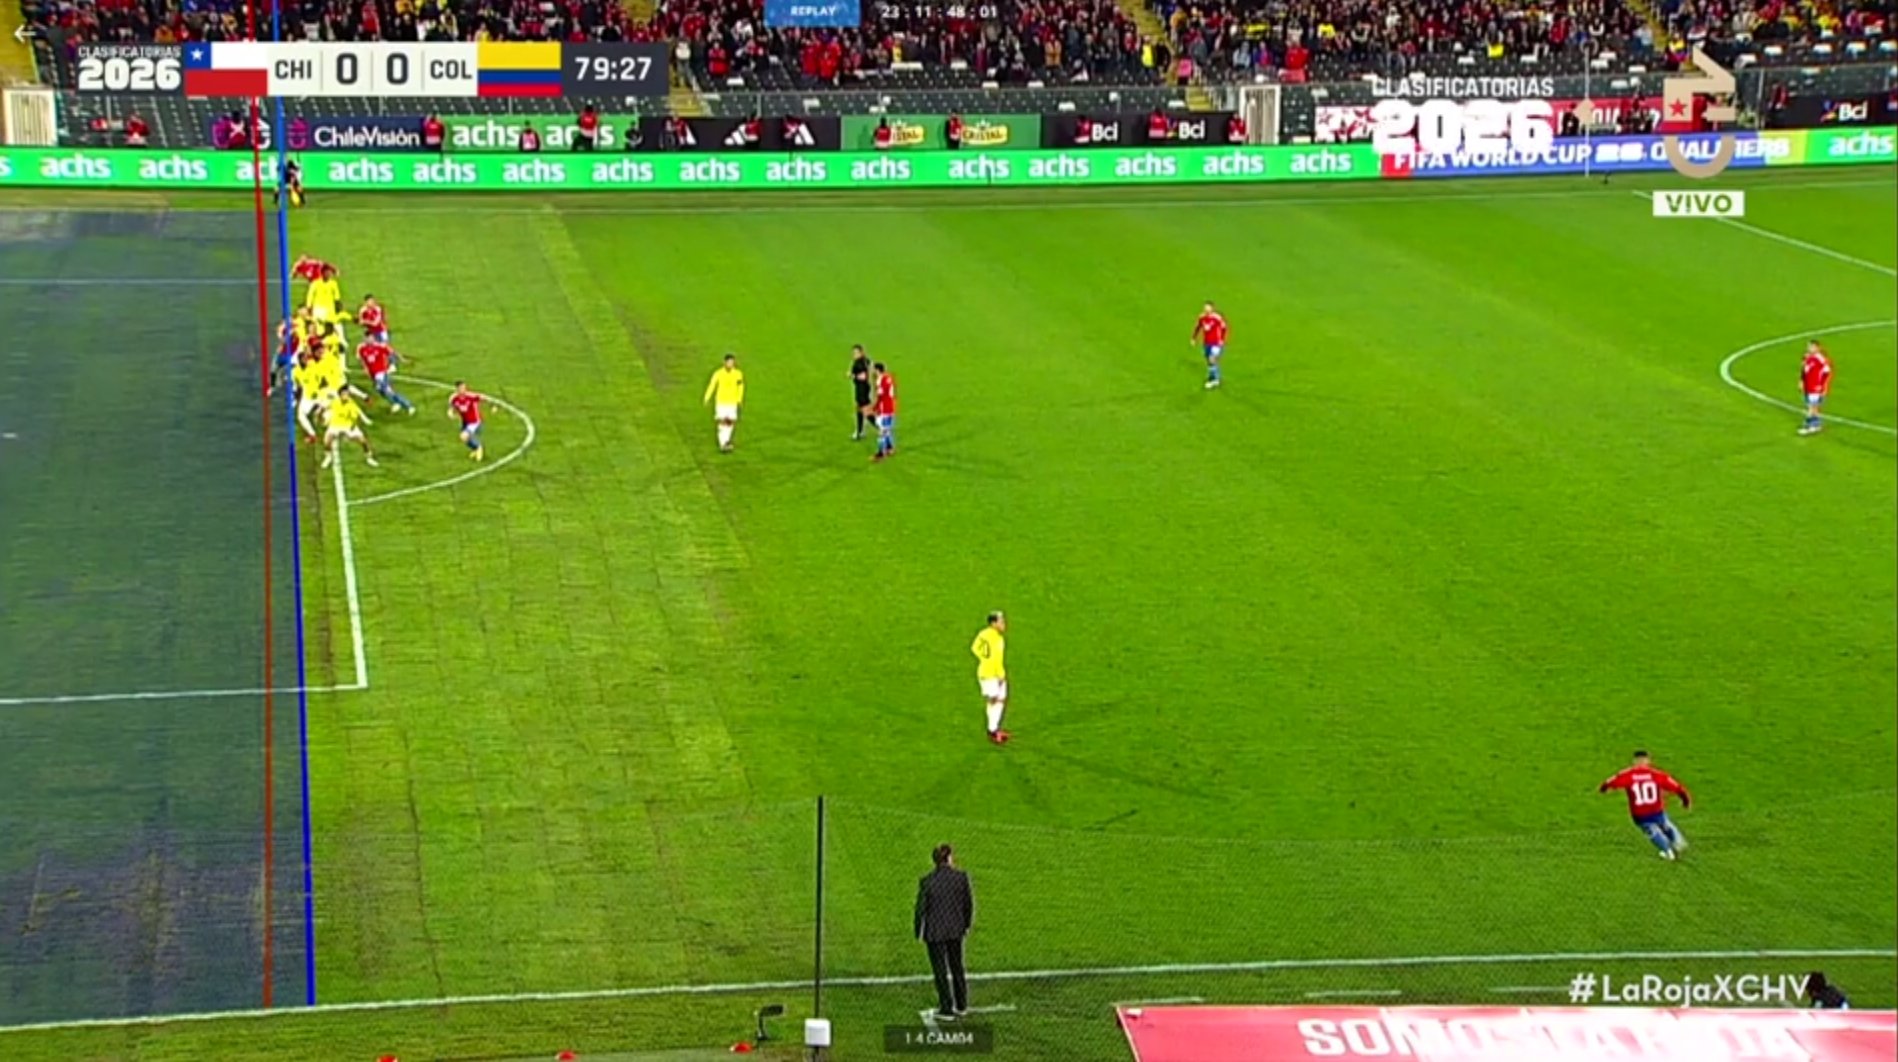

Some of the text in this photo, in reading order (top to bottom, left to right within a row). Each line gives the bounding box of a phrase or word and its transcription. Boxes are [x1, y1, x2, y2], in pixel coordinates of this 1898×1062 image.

[313, 125, 421, 147] ChileVisión
[452, 121, 614, 147] achs acs
[1828, 130, 1894, 156] achs
[40, 152, 111, 178] achs
[139, 154, 207, 180] achs
[329, 156, 393, 182] achs
[413, 156, 477, 183] achs
[503, 157, 566, 183] achs
[592, 158, 654, 183] achs
[680, 157, 741, 182] achs
[766, 156, 826, 182] achs
[850, 155, 911, 180] achs
[948, 153, 1010, 179] achs
[1028, 153, 1090, 178] achs
[1115, 151, 1177, 177] achs
[1203, 149, 1265, 175] achs
[1290, 148, 1352, 174] achs
[1541, 144, 1592, 165] CUP
[1631, 781, 1658, 806] 10
